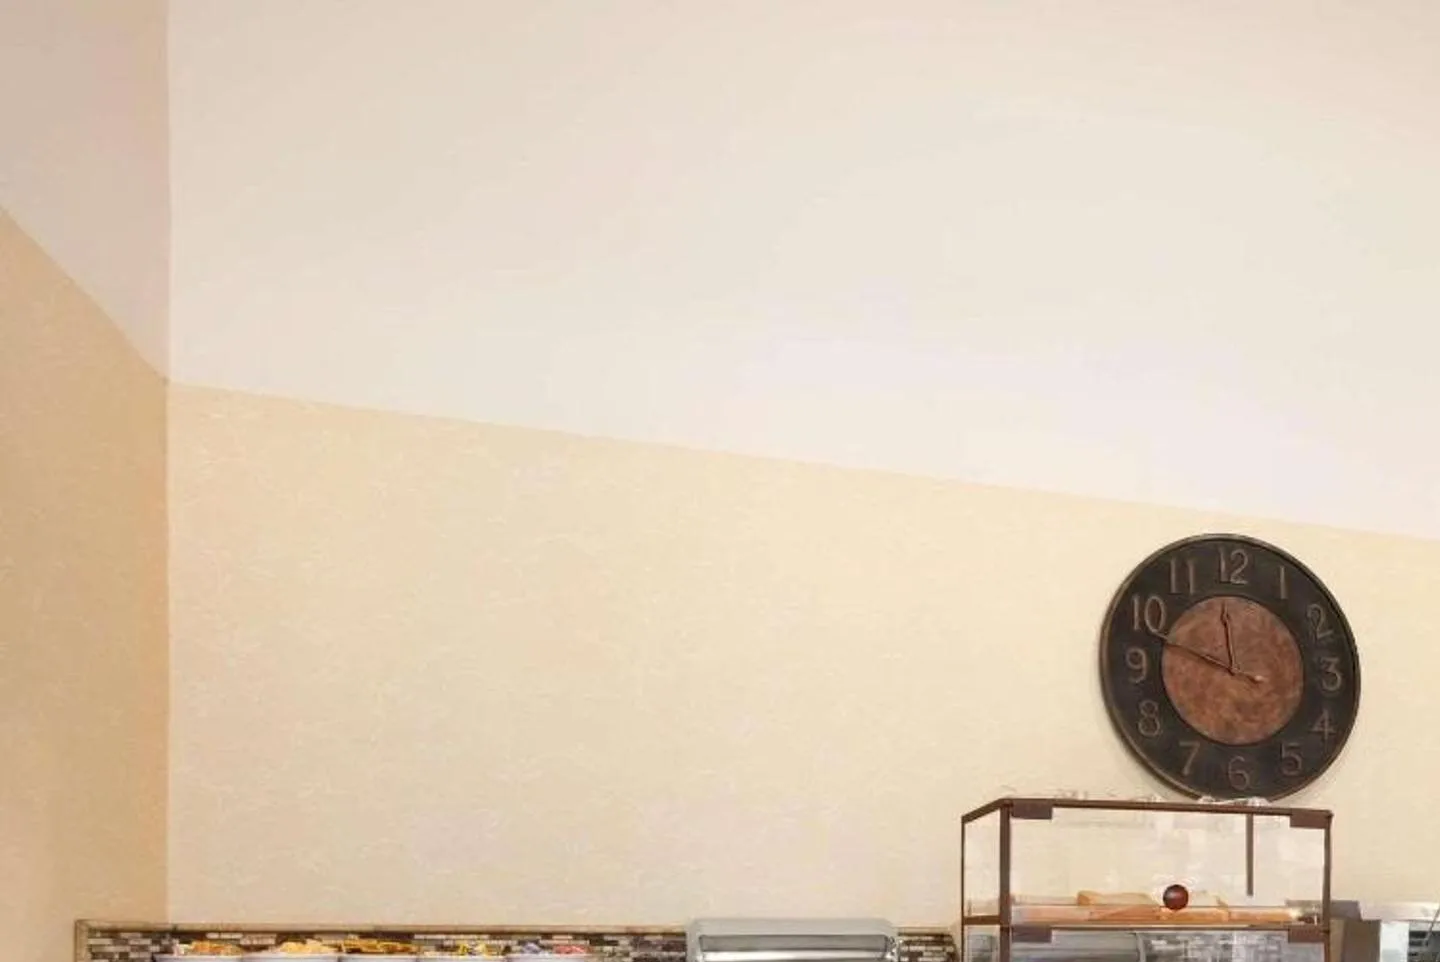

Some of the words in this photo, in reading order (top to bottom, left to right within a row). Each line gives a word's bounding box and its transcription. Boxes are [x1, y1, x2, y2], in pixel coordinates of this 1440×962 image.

[1170, 557, 1196, 594] 11
[1218, 548, 1249, 585] 12
[1279, 566, 1288, 599] 1
[1132, 595, 1167, 633] 10
[1307, 603, 1334, 639] 2
[1126, 648, 1148, 684] 9
[1319, 656, 1342, 691] 3
[1138, 699, 1161, 736] 8
[1311, 709, 1337, 742] 4
[1179, 741, 1199, 775] 7
[1228, 756, 1249, 790] 6
[1281, 742, 1301, 776] 5
